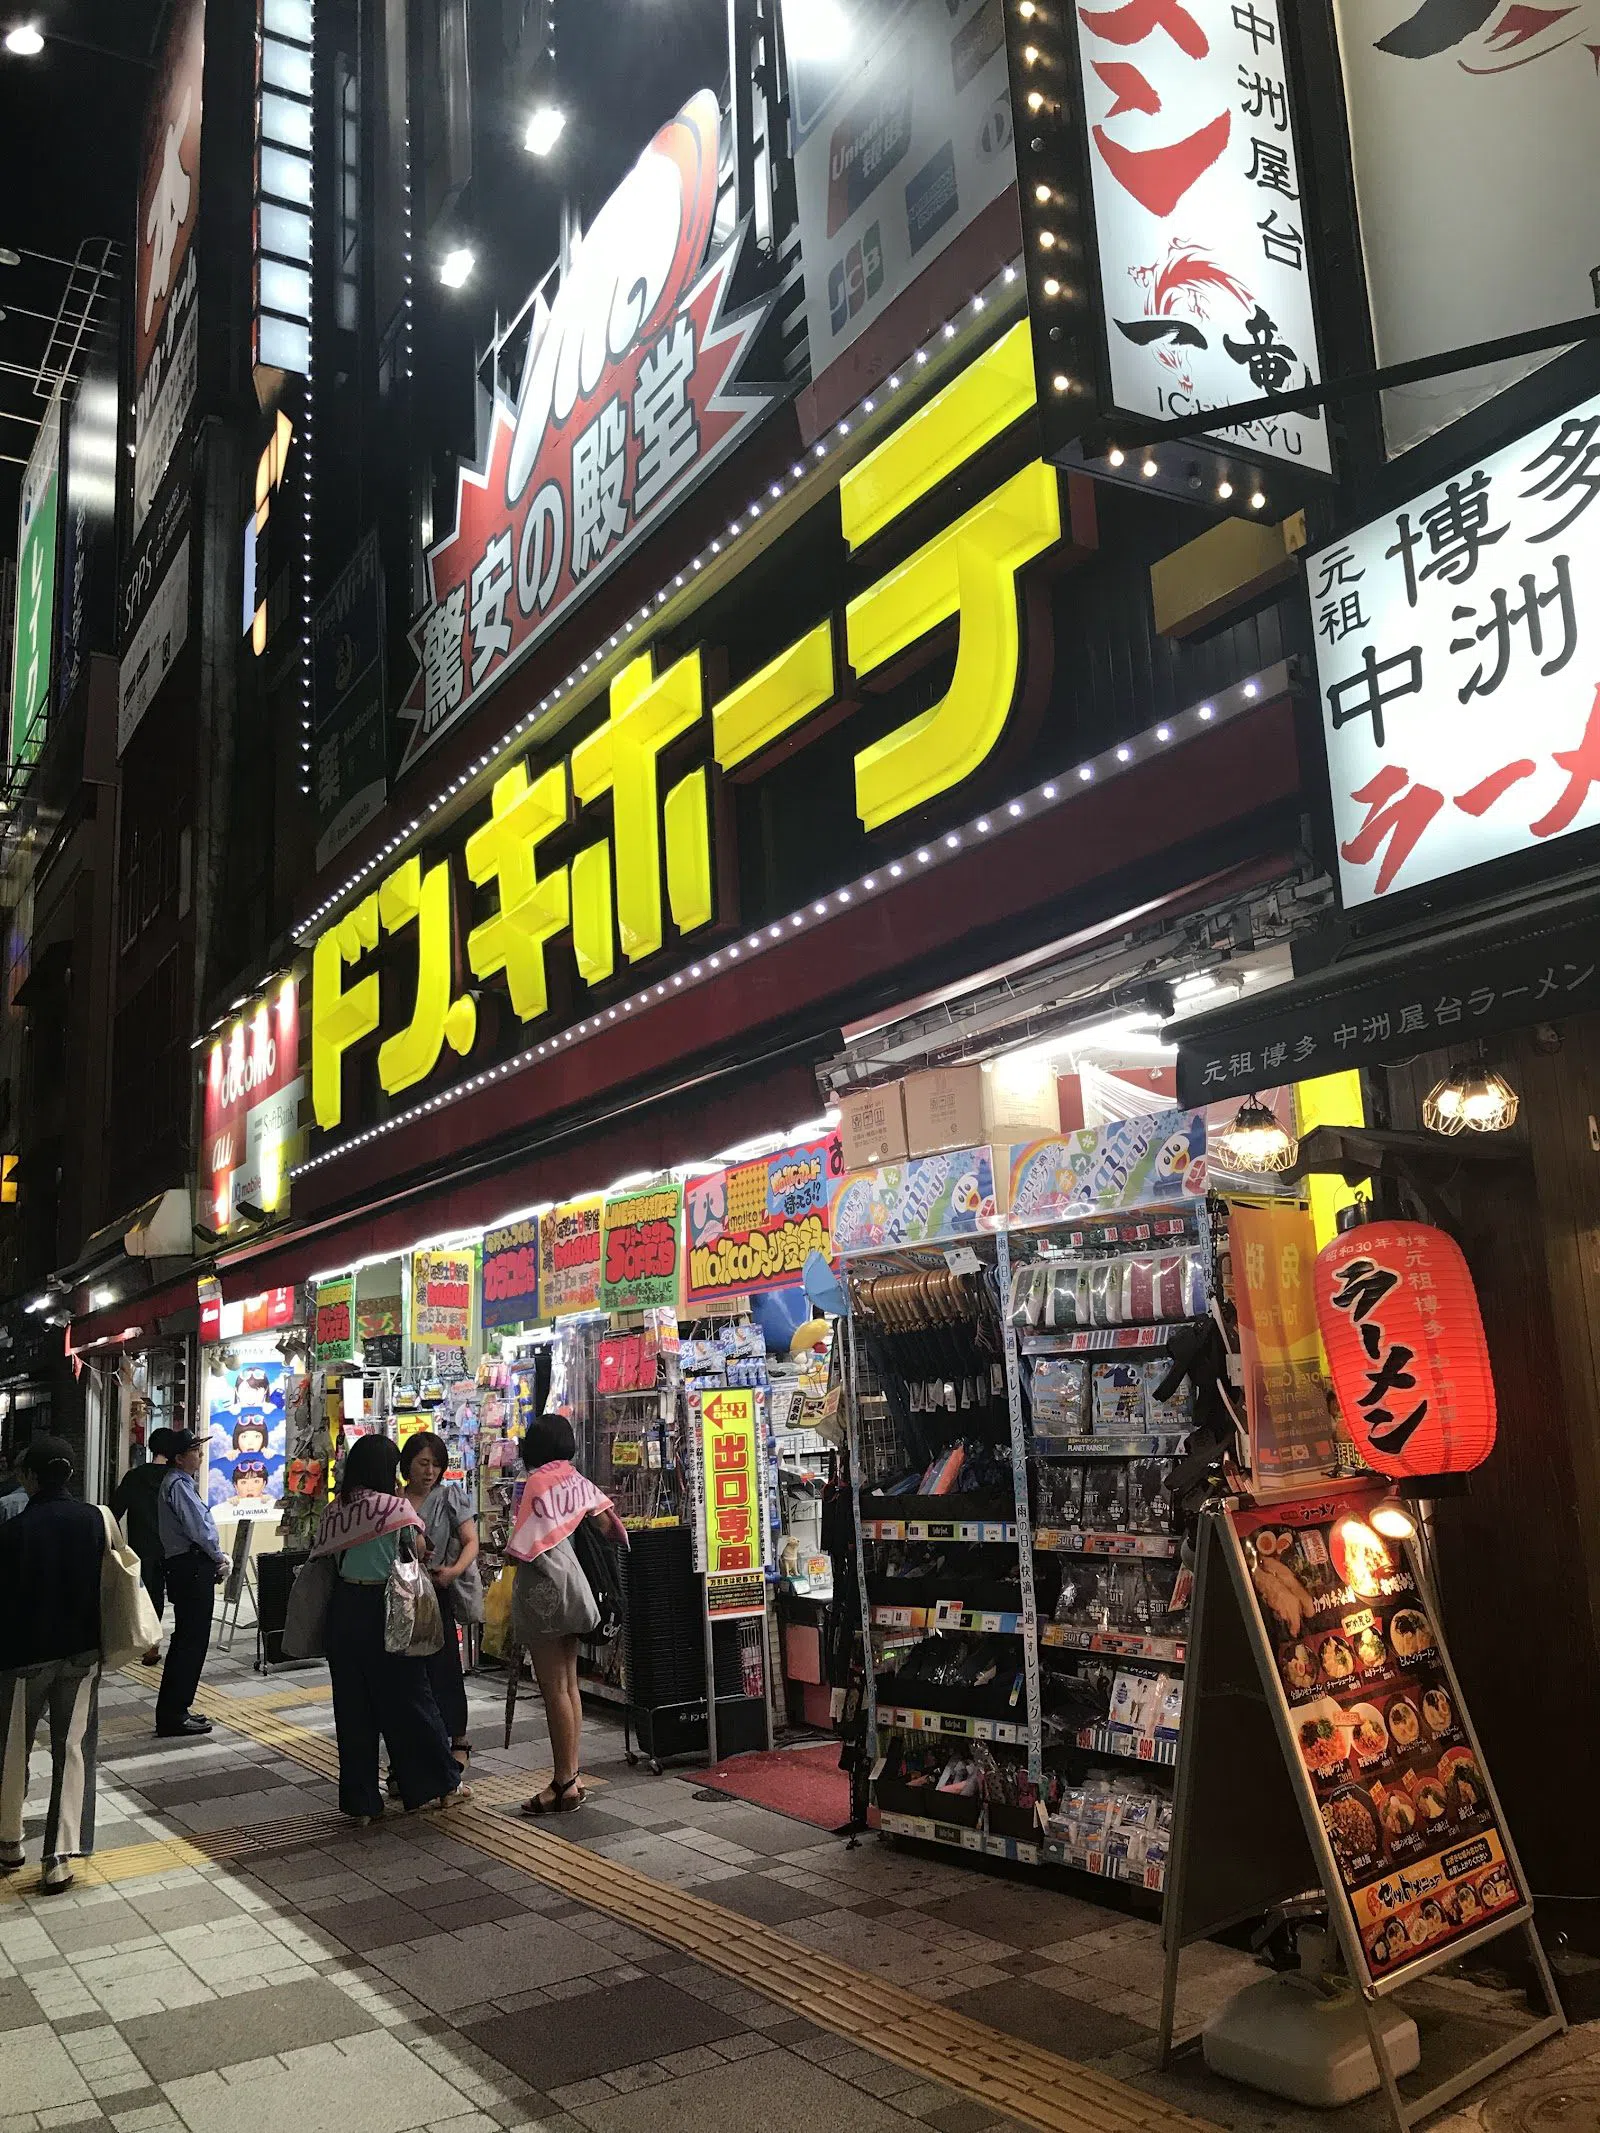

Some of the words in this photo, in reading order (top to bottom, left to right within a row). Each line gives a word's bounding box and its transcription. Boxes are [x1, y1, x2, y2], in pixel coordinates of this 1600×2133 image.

[1231, 3, 1303, 271] 中洲屋台
[422, 316, 700, 736] 驚安の殿堂
[1385, 414, 1600, 607] 博多
[1315, 545, 1371, 645] 元祖
[1326, 555, 1578, 748] 中洲
[1201, 1035, 1318, 1087] 元祖博多
[1333, 962, 1597, 1051] 中洲屋台ラーメン
[221, 1038, 276, 1110] docomo
[262, 1103, 295, 1137] SoftBank
[211, 1132, 234, 1173] au
[1024, 1146, 1065, 1216] レイングッズ
[1111, 1114, 1158, 1191] Days!
[844, 1181, 873, 1245] レイングッズ
[915, 1156, 951, 1224] Days!
[1324, 1236, 1432, 1263] 昭和30年創業
[1332, 1260, 1428, 1455] ラーメン
[712, 1403, 744, 1412] EXIT
[712, 1411, 745, 1419] ONLY
[245, 1508, 269, 1517] WiMAX
[1057, 1537, 1073, 1545] SUIT
[1016, 1505, 1040, 1756] 雨の日も快適に過ごすレイングッズ
[1063, 1632, 1080, 1642] SUIT
[1150, 1602, 1169, 1613] SUIT
[1176, 1650, 1183, 1659] M
[1400, 1648, 1436, 1667] とんこつラーメン
[1377, 1873, 1443, 1910] セットメニュー
